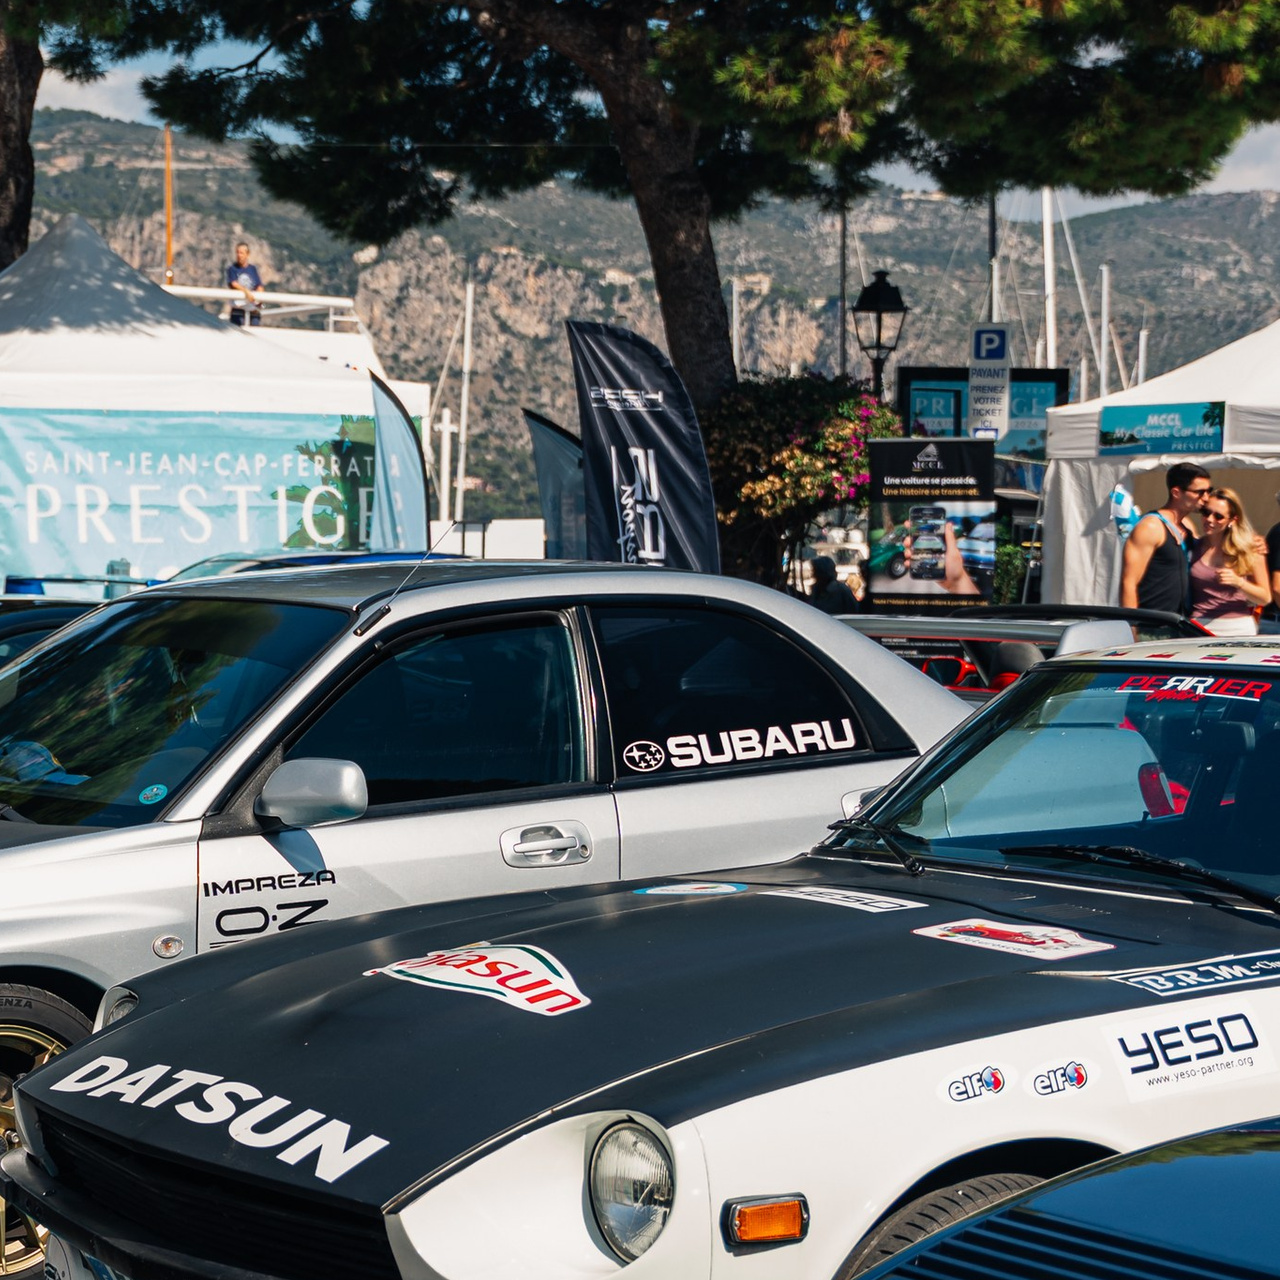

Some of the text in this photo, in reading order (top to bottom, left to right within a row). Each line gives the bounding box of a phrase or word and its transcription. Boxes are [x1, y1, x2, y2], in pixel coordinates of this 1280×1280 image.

[980, 333, 1000, 358] P
[971, 368, 1006, 379] PAYANT
[971, 385, 1005, 394] PRENEZ
[973, 397, 1002, 405] VOTRE
[972, 408, 1002, 416] TICKET
[1146, 413, 1182, 426] MCCL
[1113, 422, 1214, 440] My Classic Car Life
[883, 476, 900, 485] Une
[901, 476, 930, 485] voiture
[930, 477, 940, 485] se
[882, 488, 899, 496] Une
[899, 488, 930, 496] histoire
[666, 718, 856, 768] SUBARU
[202, 869, 337, 898] IMPREZA
[1117, 1012, 1259, 1075] YESO
[1033, 1067, 1066, 1096] elf
[1146, 1055, 1254, 1087] www.yeso-partner.org
[948, 1072, 982, 1102] elf
[49, 1055, 391, 1184] DATSUN
